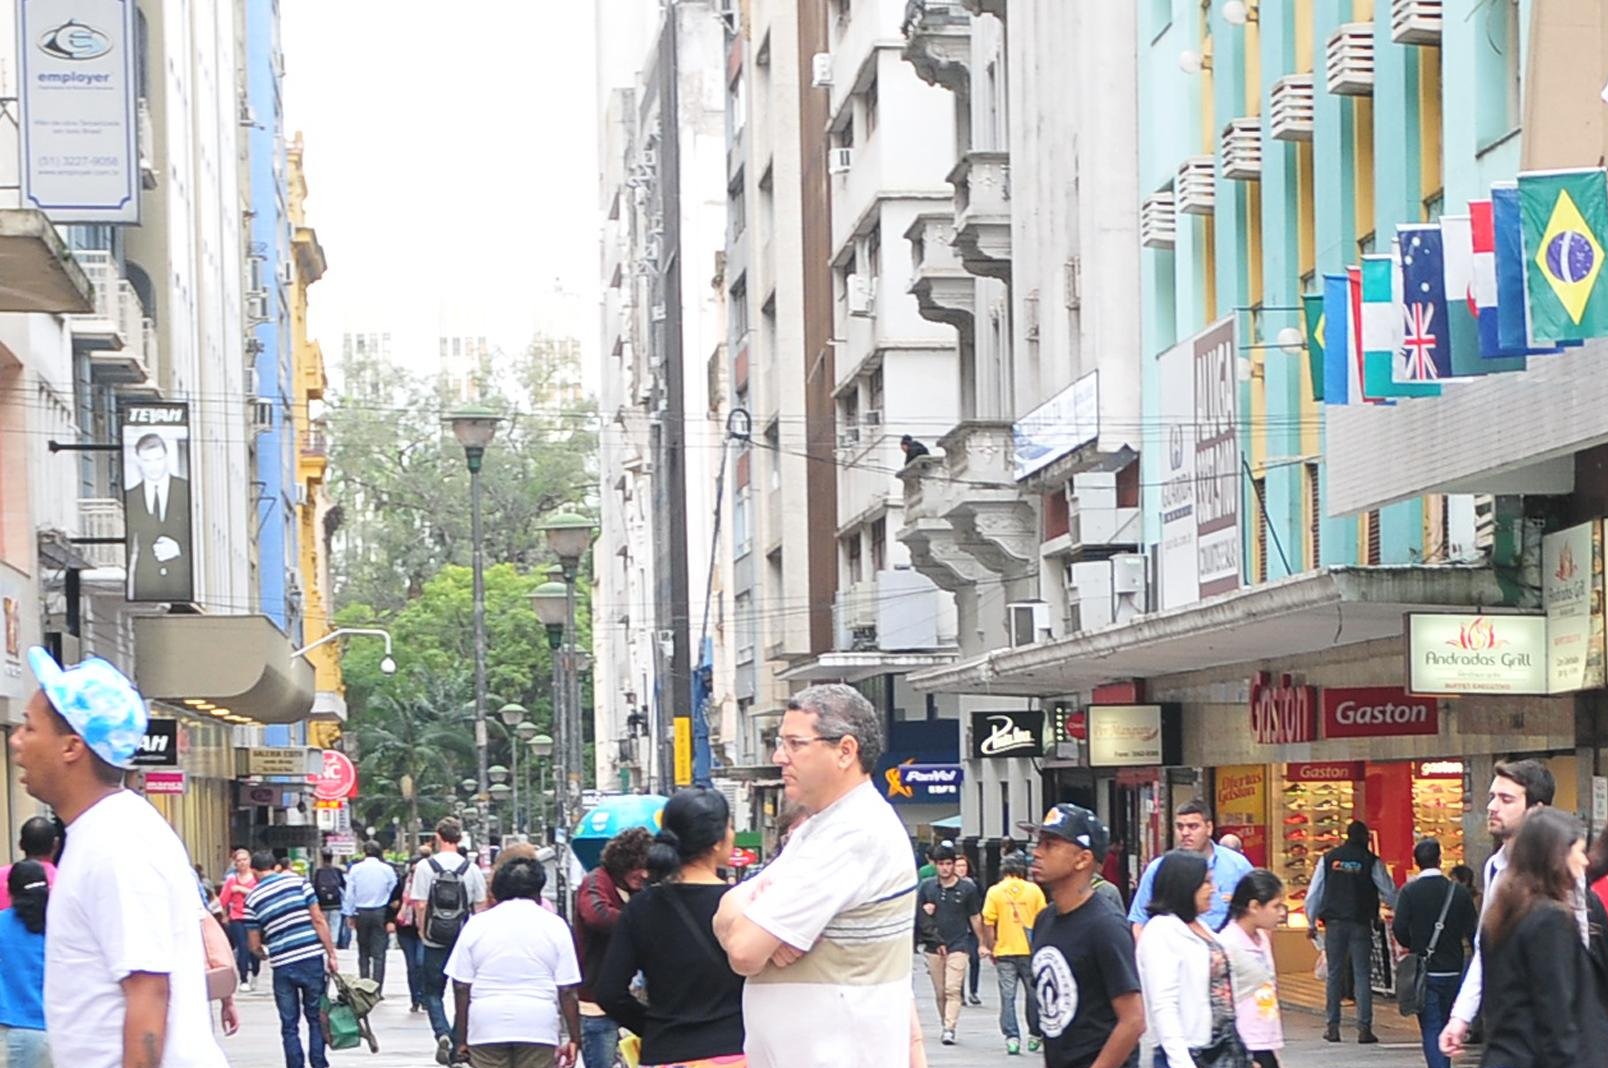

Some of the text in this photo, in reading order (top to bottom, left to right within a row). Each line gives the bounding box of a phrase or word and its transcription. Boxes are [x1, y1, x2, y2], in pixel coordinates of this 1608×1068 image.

[37, 70, 110, 85] employer
[130, 407, 184, 423] TEVAH
[1425, 651, 1532, 668] Andradas Grill
[1335, 700, 1427, 725] Gaston
[1299, 764, 1350, 779] Gaston
